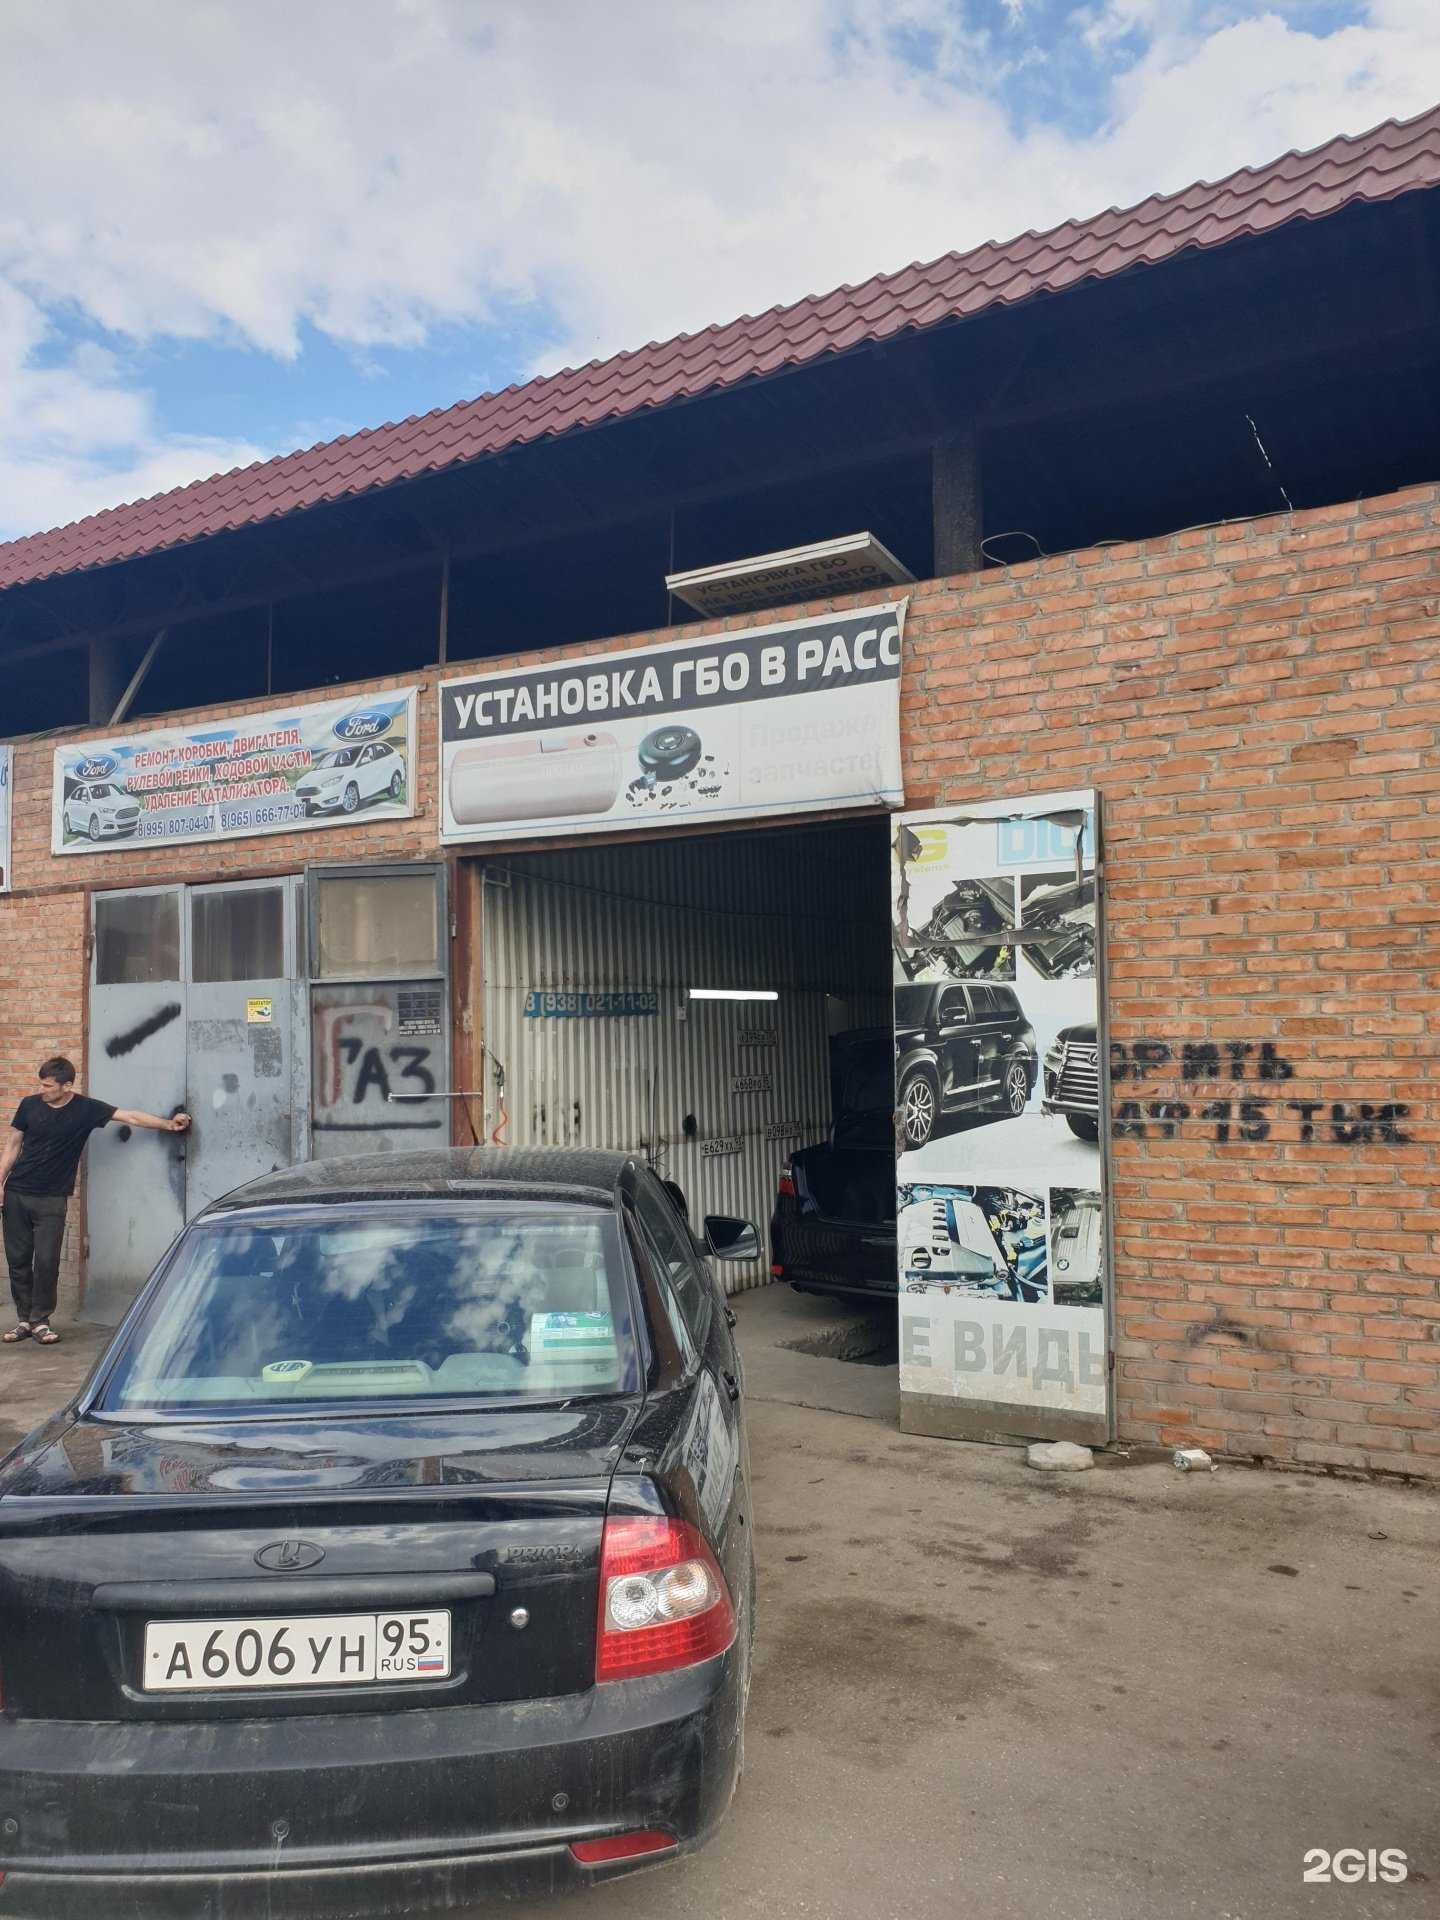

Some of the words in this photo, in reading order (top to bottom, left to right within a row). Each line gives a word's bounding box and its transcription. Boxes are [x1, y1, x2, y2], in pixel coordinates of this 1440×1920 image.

[696, 565, 806, 595] УСТАНОВКА
[809, 557, 848, 575] ГБО
[825, 564, 878, 582] АВТО
[454, 666, 664, 729] УСТАНОВКА
[673, 652, 750, 700] ГБО
[760, 646, 786, 686] В
[797, 624, 901, 682] РАСС
[345, 715, 379, 736] Ford
[83, 758, 109, 776] Ford
[135, 749, 176, 769] РЕМОНТ
[127, 769, 173, 791] РУЛЕВОЙ
[215, 755, 269, 781] ХОДОВОЙ
[272, 750, 312, 770] ЧАСТИ
[144, 790, 198, 812] УДАЛЕНИЕ
[505, 1543, 585, 1564] PRIORA
[382, 1618, 431, 1657] 95
[381, 1657, 416, 1672] RUS
